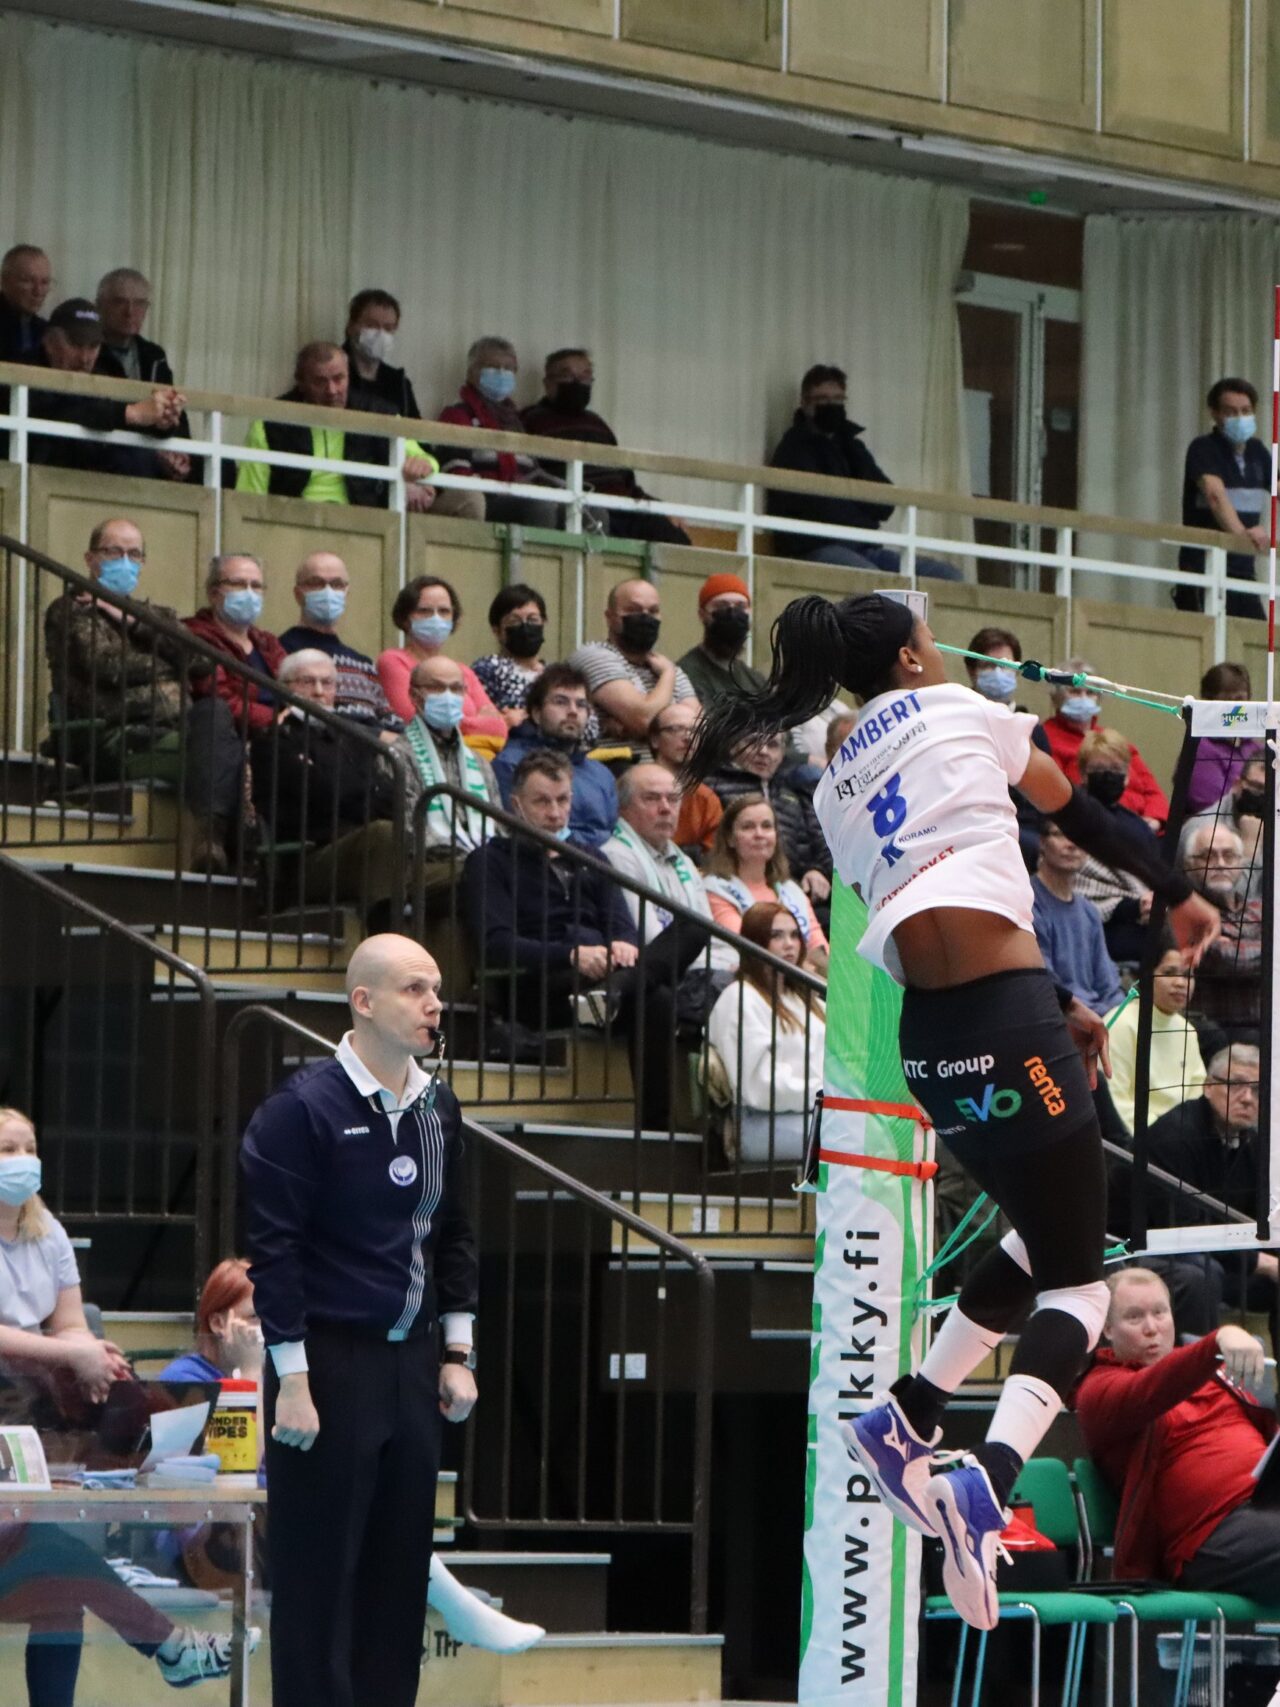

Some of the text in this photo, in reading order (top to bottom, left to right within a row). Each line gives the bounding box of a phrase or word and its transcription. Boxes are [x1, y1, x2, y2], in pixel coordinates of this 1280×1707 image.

[866, 772, 907, 839] 8
[898, 825, 938, 844] KORAMO
[903, 1054, 995, 1079] KTC Group
[1023, 1055, 1068, 1117] renta
[954, 1083, 1022, 1123] EVO
[838, 1230, 888, 1685] www.plkky.fi
